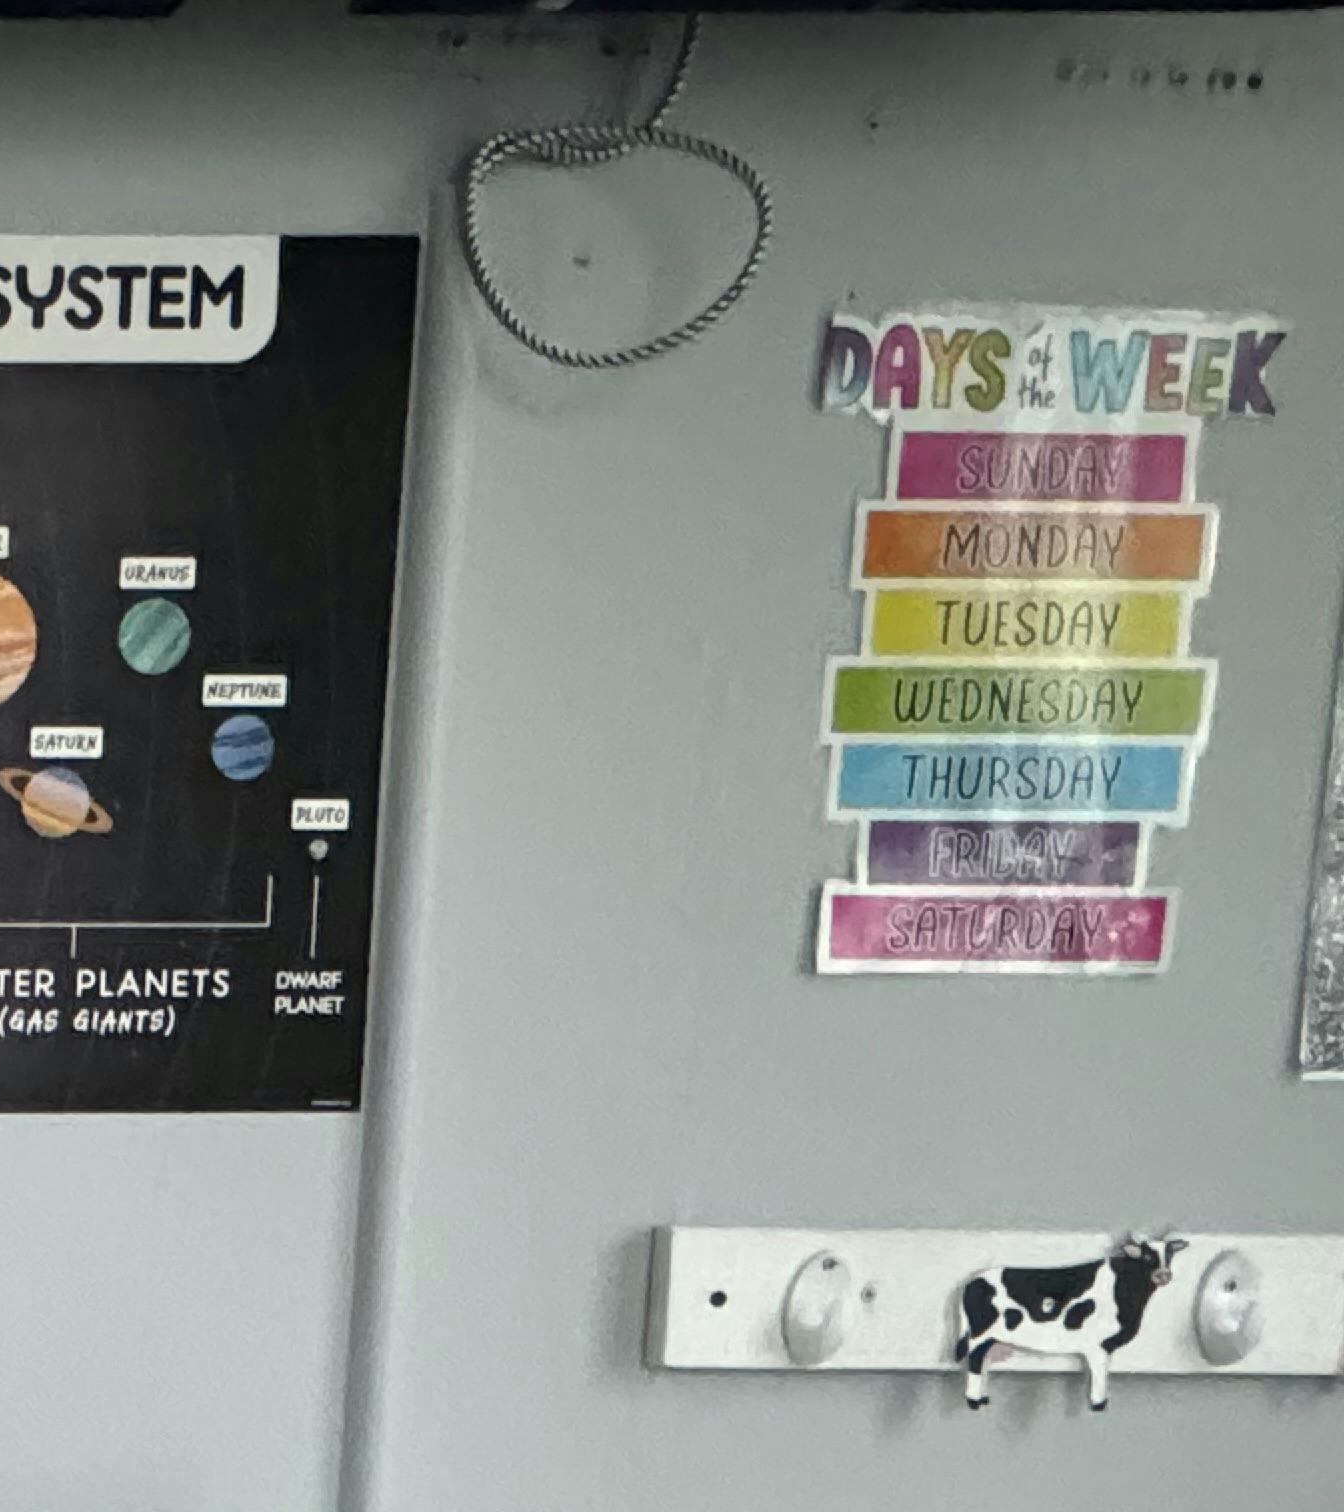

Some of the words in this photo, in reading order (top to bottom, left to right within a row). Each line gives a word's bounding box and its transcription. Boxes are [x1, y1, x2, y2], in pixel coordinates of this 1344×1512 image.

[820, 324, 1012, 413] DAYS
[1028, 335, 1055, 372] of
[1068, 328, 1288, 417] WEEK
[1017, 380, 1057, 410] the
[957, 444, 1127, 492] SUNDAY
[942, 522, 1126, 568] MONDAY
[124, 563, 190, 583] URANUS
[935, 600, 1122, 648] TUESDAY
[206, 682, 283, 701] NEPTUNE
[894, 677, 1144, 724] WEDNESDAY
[33, 733, 98, 752] SATURN
[902, 754, 1122, 801] THURSDAY
[294, 807, 346, 825] PLUTO
[928, 826, 1075, 878] FRIDAY
[886, 902, 1106, 952] SATURDAY
[75, 967, 231, 998] PLANETS
[275, 970, 343, 990] DWARF
[72, 1003, 176, 1037] GIANTS)
[274, 996, 345, 1016] PLANET
